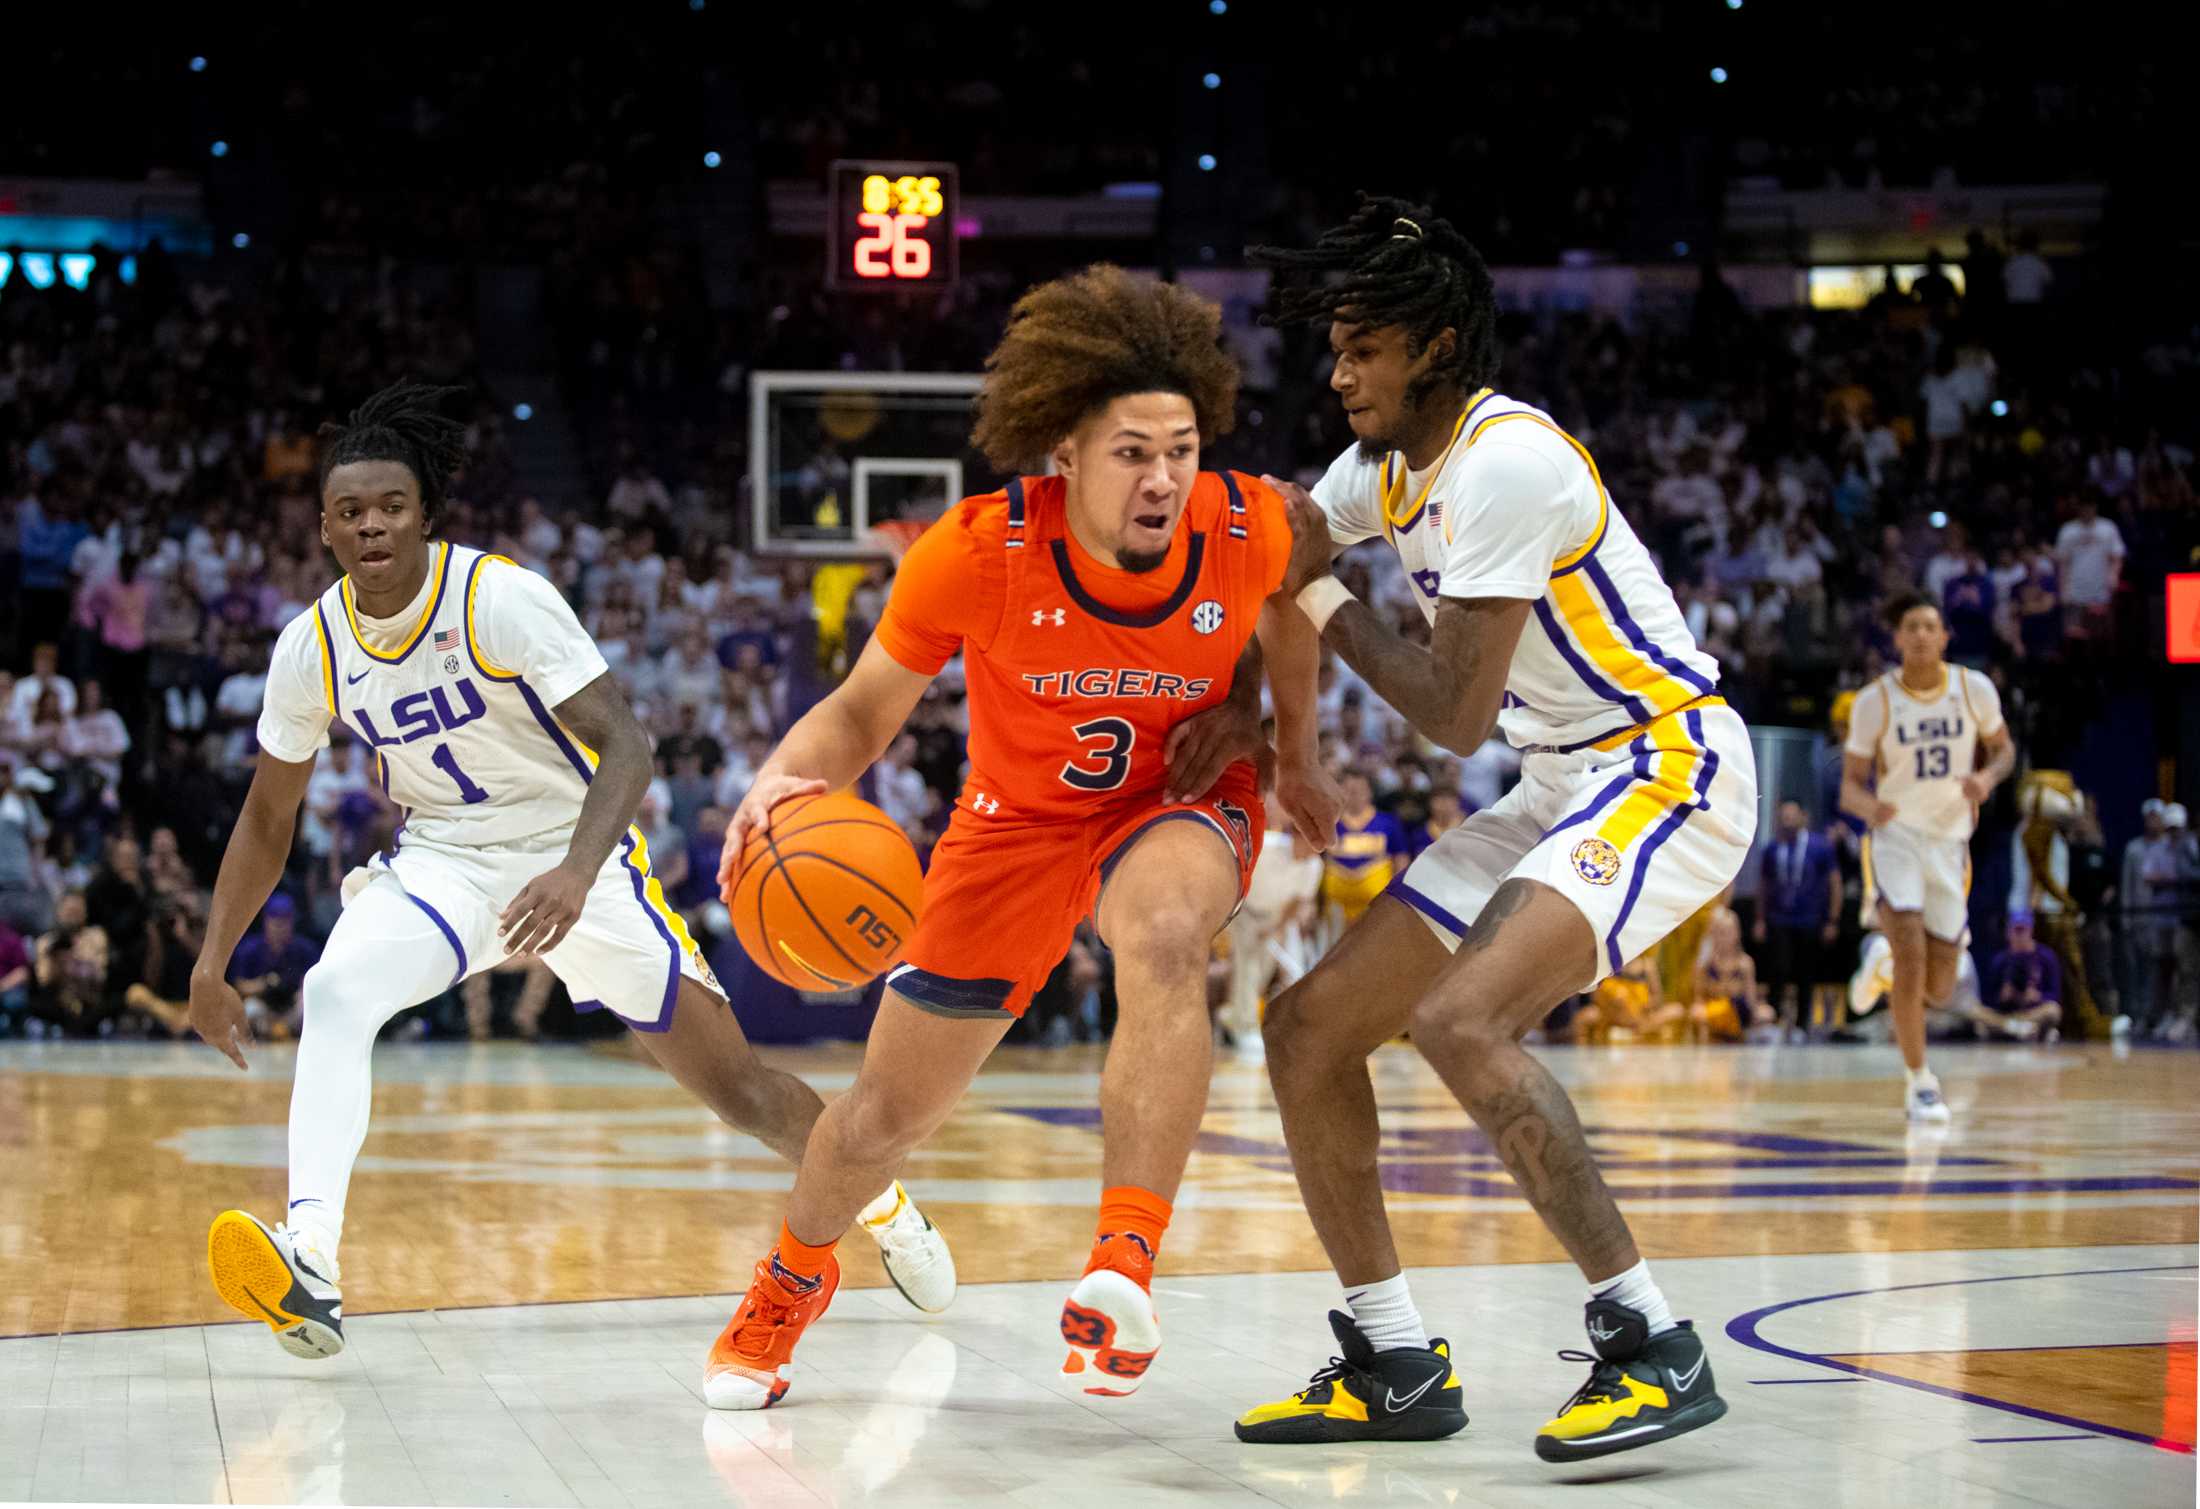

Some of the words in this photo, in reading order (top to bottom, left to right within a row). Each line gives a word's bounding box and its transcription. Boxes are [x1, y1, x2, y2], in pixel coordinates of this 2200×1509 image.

[855, 212, 931, 277] 26
[1192, 600, 1224, 634] SEC
[353, 677, 487, 747] LSU
[1022, 668, 1213, 701] TIGERS
[1058, 716, 1136, 791] 3
[1897, 717, 1963, 745] LSU
[431, 743, 490, 804] 1
[1915, 746, 1950, 779] 13
[846, 904, 902, 960] LSU
